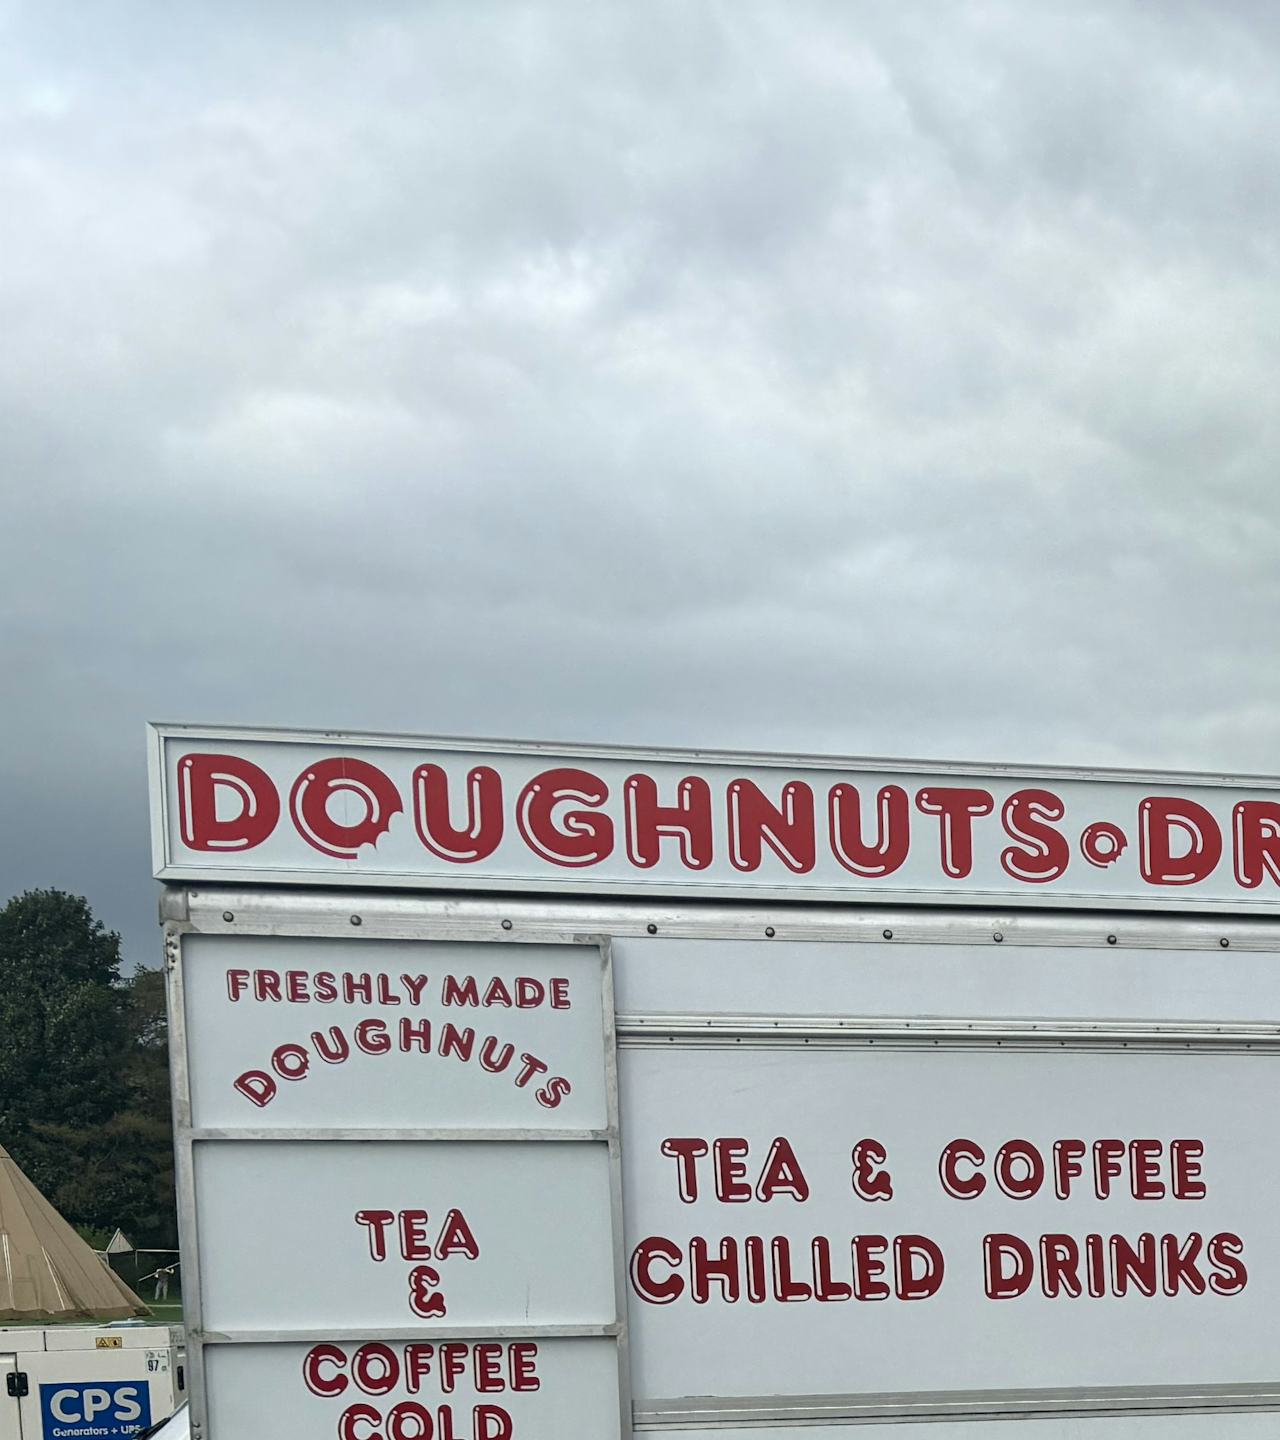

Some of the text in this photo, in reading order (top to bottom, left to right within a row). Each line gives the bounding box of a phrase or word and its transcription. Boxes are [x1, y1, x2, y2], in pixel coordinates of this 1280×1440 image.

[177, 752, 1070, 884] DOUGHNUTS
[226, 968, 571, 1010] FRESHLY MADE
[233, 1017, 572, 1109] DOUGHNUTS
[661, 1137, 1208, 1204] TEA & COFFEE
[355, 1208, 479, 1262] TEA
[409, 1265, 446, 1319] &
[629, 1231, 1249, 1305] CHILLED DRINKS
[302, 1342, 541, 1397] COFFEE
[50, 1387, 142, 1423] CPS
[53, 1424, 141, 1437] Generators + UPS
